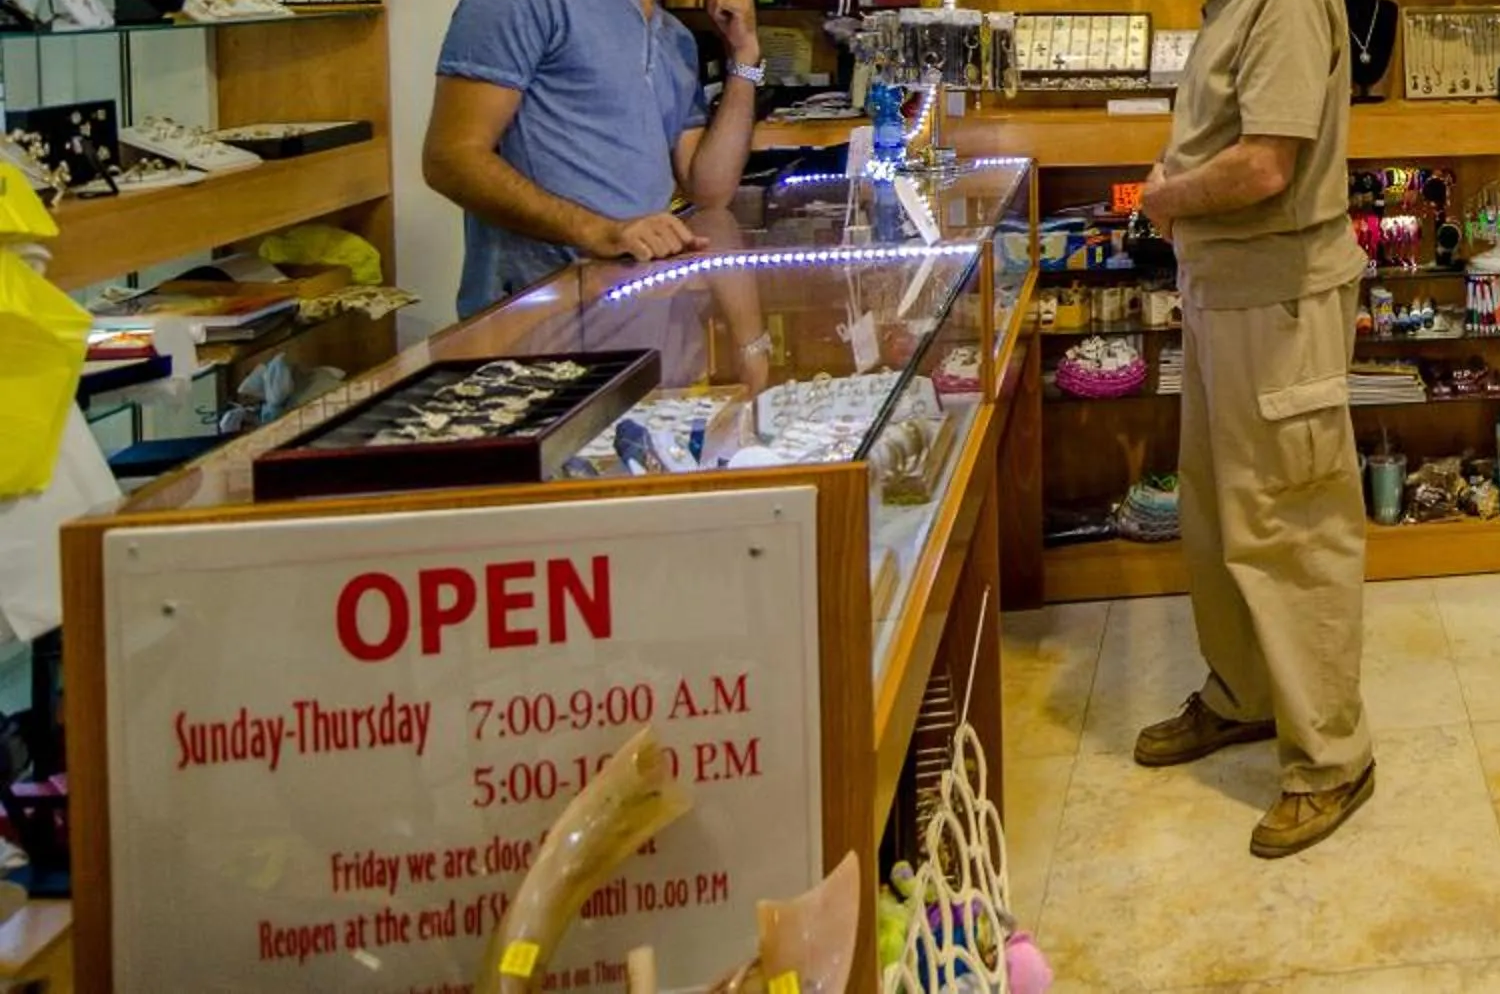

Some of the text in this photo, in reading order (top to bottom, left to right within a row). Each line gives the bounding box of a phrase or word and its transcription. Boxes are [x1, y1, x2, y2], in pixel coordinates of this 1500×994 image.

[337, 555, 611, 662] OPEN
[175, 673, 750, 772] Sunday-Thursday 7:00-9:00 A.M
[693, 738, 762, 783] P.M
[330, 850, 400, 895] Friday
[406, 851, 436, 883] we
[443, 846, 477, 879] are
[485, 835, 532, 874] close
[259, 920, 336, 966] Reopen
[345, 914, 367, 950] at
[375, 907, 410, 946] the
[418, 899, 455, 940] end
[464, 895, 484, 937] of
[635, 878, 688, 911] 10.00
[696, 872, 728, 904] P.M
